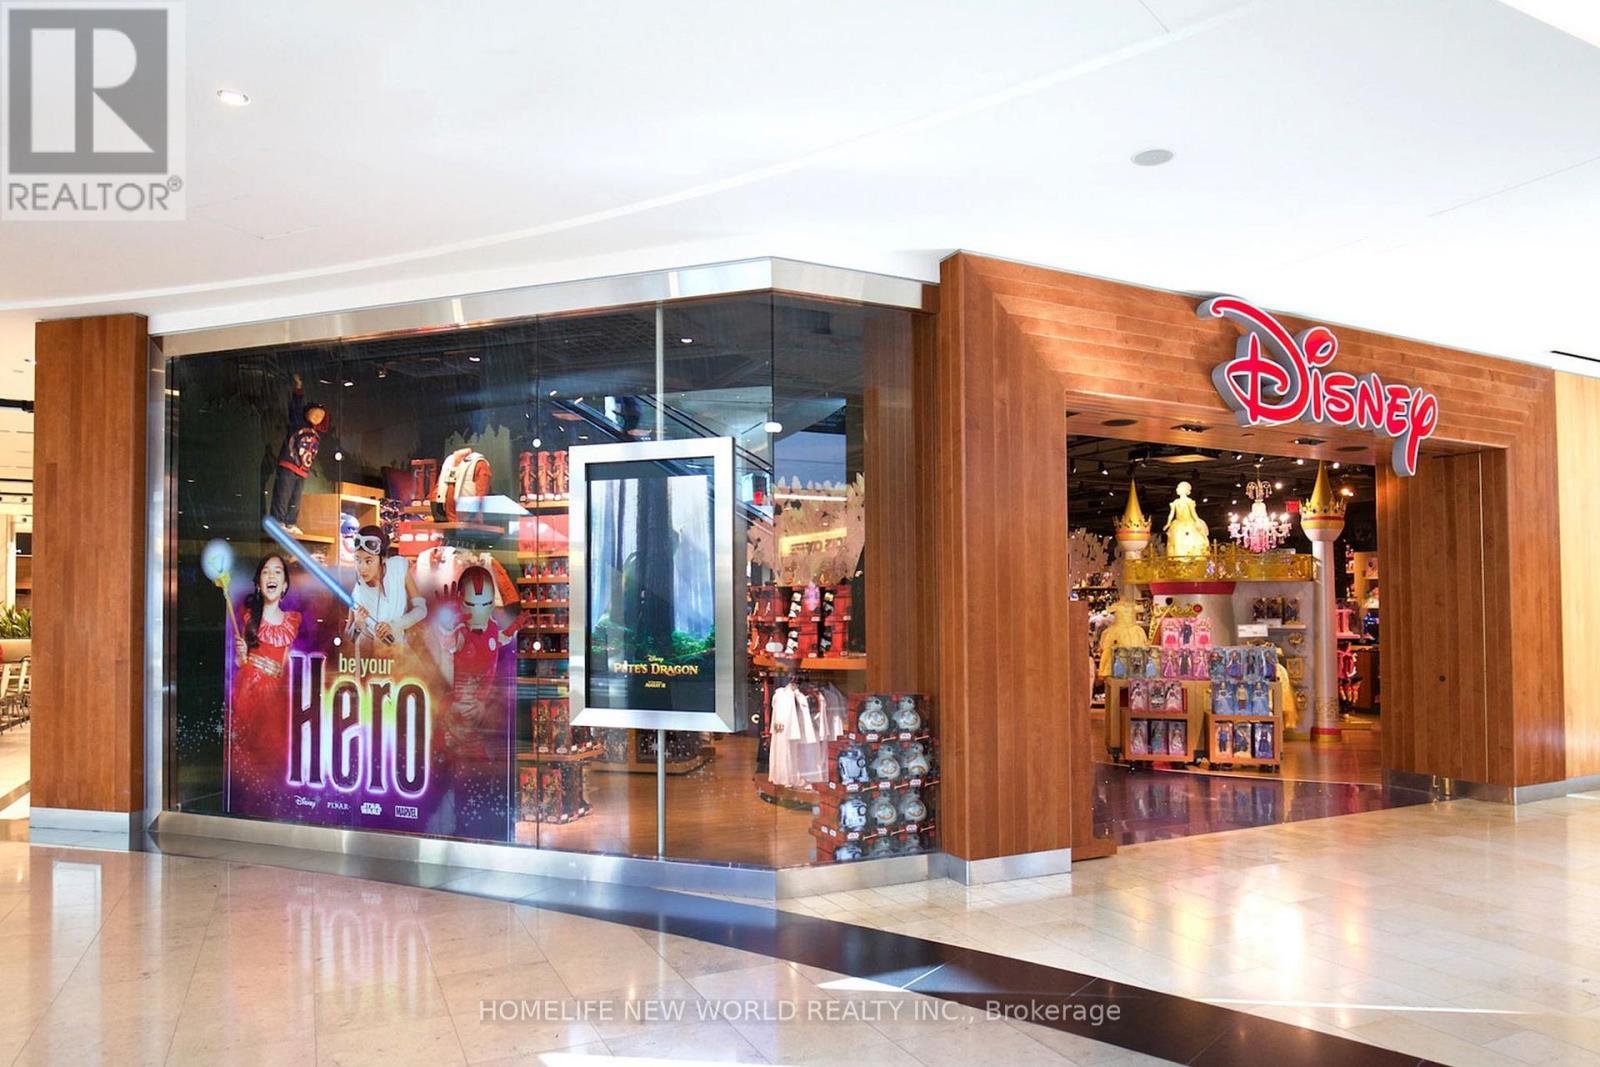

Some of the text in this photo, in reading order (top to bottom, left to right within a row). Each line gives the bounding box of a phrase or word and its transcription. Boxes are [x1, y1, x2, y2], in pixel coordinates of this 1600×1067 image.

[339, 652, 395, 678] be your
[288, 652, 429, 798] Hero
[396, 807, 417, 818] MARVEL
